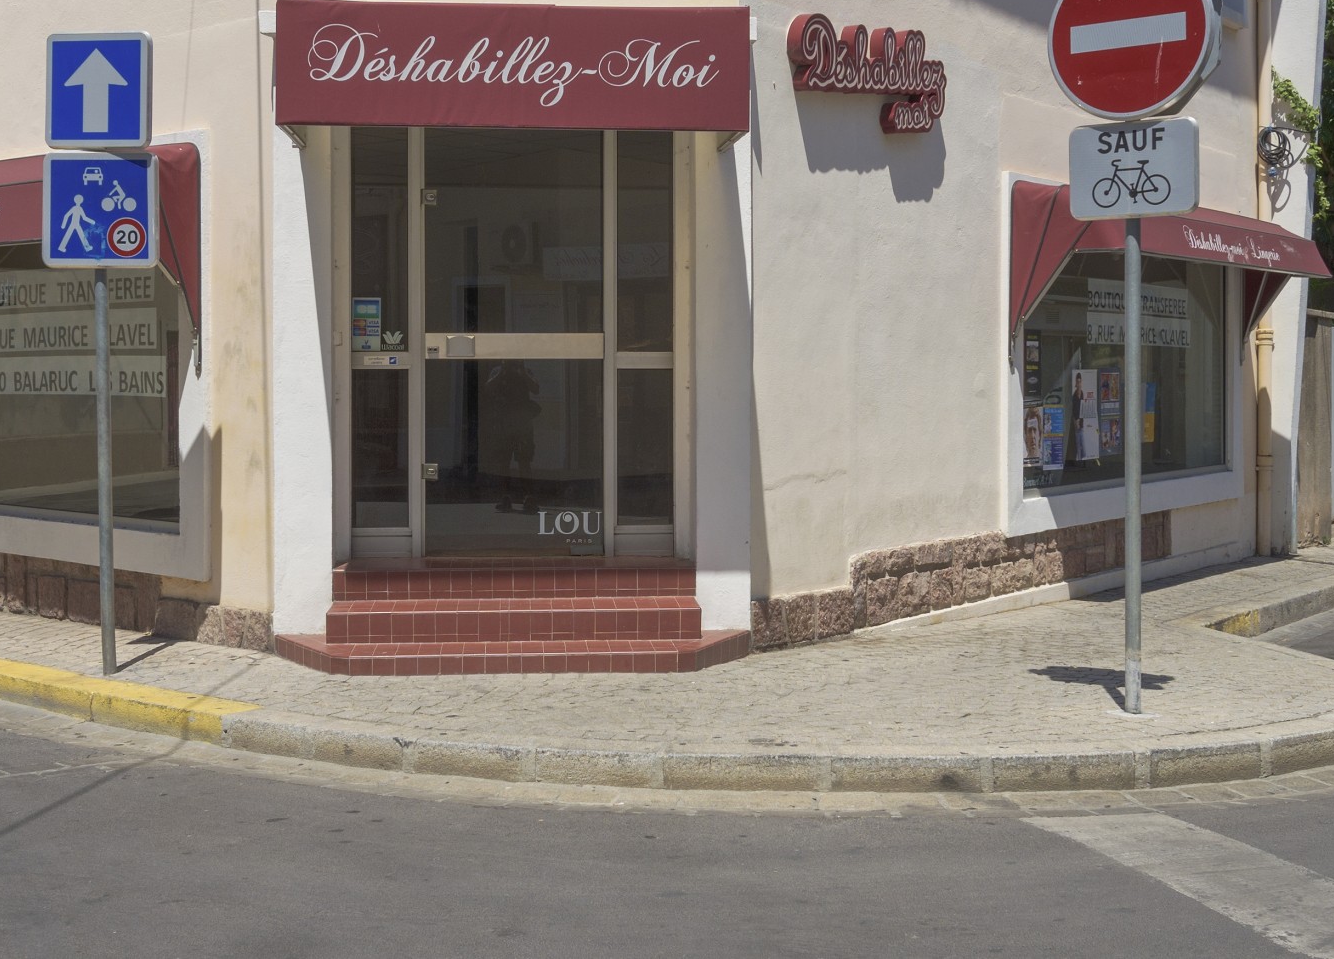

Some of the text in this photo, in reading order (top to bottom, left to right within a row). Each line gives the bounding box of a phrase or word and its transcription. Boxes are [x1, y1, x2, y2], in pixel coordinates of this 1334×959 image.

[307, 23, 719, 107] Déshabillez-Moi
[801, 15, 946, 116] Déshabillez
[895, 98, 931, 130] moi
[1097, 127, 1165, 154] SAUF
[116, 230, 138, 244] 20
[1246, 235, 1280, 267] Lingerie
[57, 276, 151, 303] TRANFEREE
[1088, 291, 1125, 312] BOUTIQU
[23, 325, 88, 349] MAURICE
[109, 324, 155, 346] LAVEL
[1120, 326, 1156, 344] MRICE
[1160, 329, 1189, 346] CLAVEL
[13, 370, 78, 393] BALARUC
[119, 370, 164, 395] BAINS
[537, 511, 602, 535] LOU
